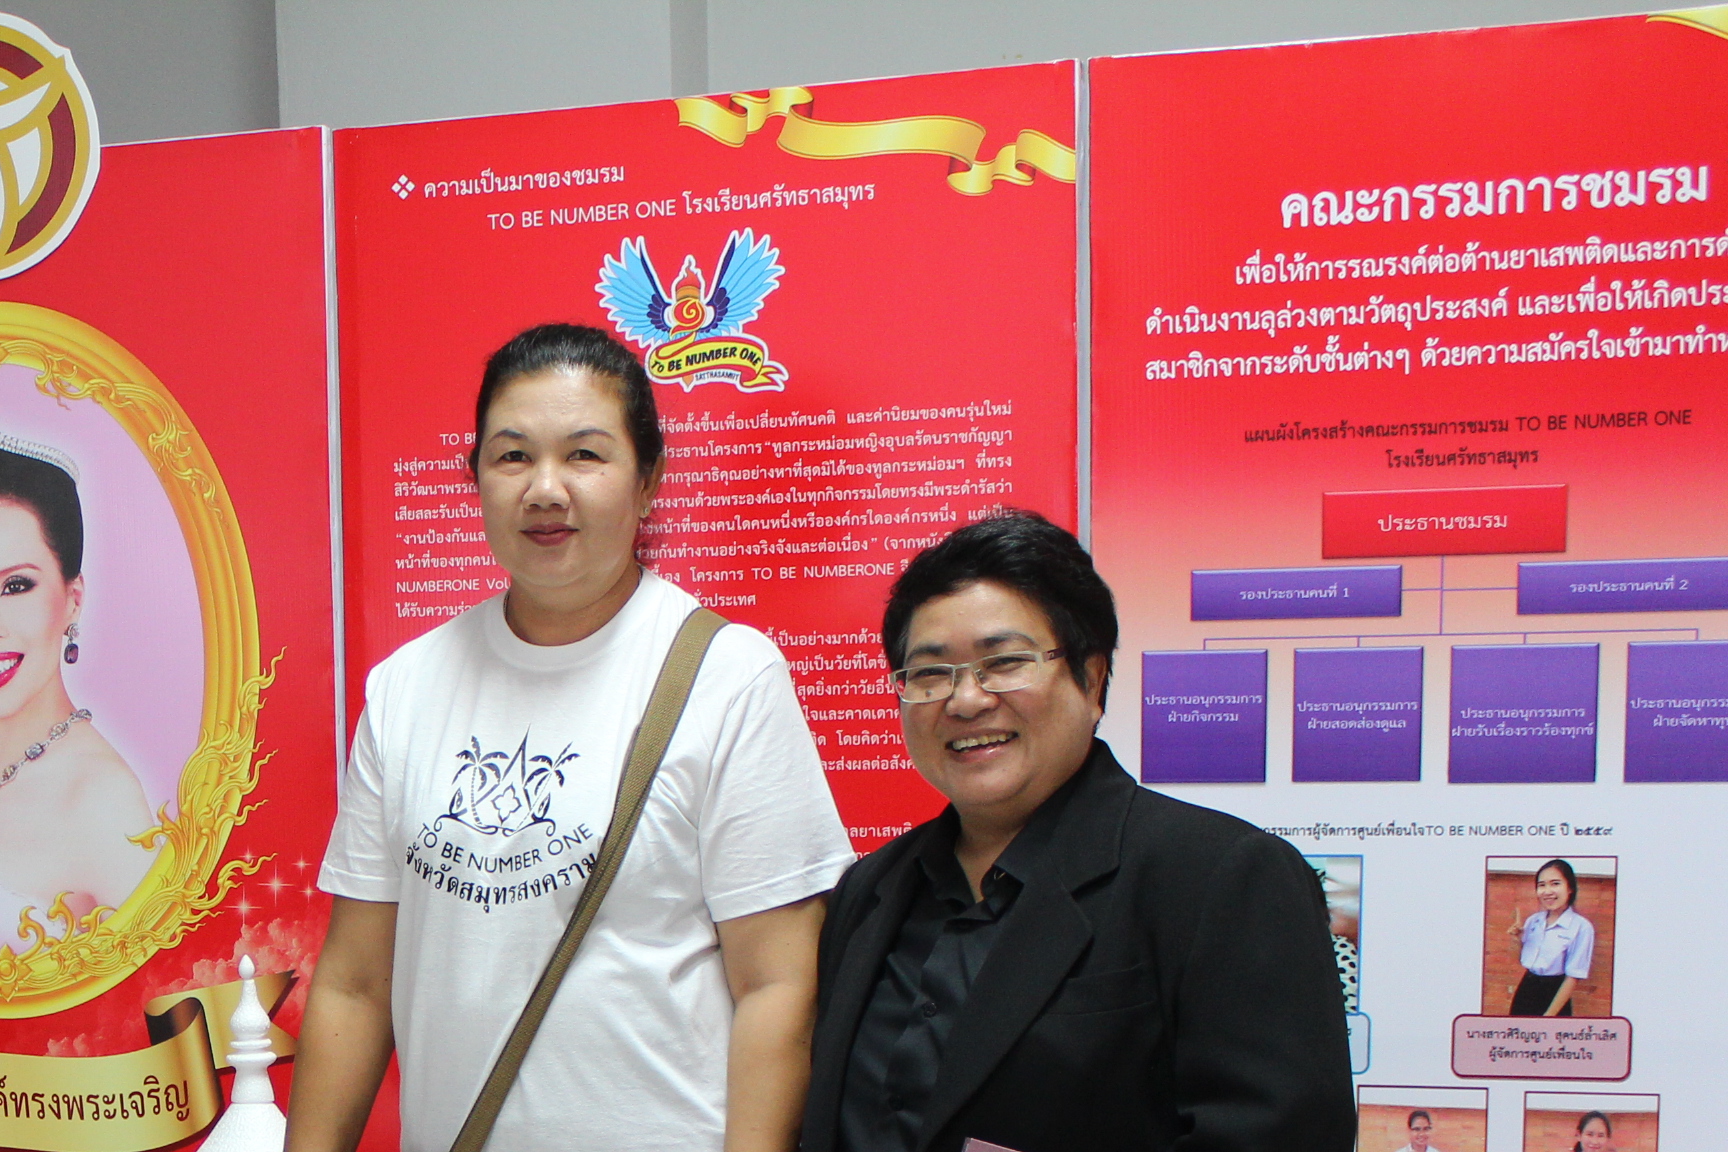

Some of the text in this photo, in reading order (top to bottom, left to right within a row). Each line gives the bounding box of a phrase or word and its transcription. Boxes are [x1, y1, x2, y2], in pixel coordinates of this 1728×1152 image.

[422, 161, 626, 202] ความเป็นมาของชมรม
[486, 181, 876, 231] TO BE NUMBER ONE โรงเรียนศรัทธาสมุทร
[1280, 165, 1709, 229] คณะกรรมการชมรม
[1145, 276, 1728, 339] ดำเนินงานลุล่วงตามวัตถุประสงค์ และเพื่อให้เกิดประ
[650, 346, 762, 373] TO BE NUMBER ONE
[1145, 325, 1728, 382] สมาชิกจากระดับชั้นต่างๆ ด้วยความสมัครใจเข้ามาทำห
[846, 399, 1013, 426] และค่านิยมของคนรุ่นใหม่
[1243, 408, 1693, 446] แผนผังโครงสร้างคณะกรรมการชมรม TO BE NUMBER ONE
[439, 433, 460, 446] TO
[660, 453, 1013, 487] หากรุณาธิคุณอย่างหาที่สุดมิได้ของทูลกระหม่อมฯ ที่ทรง
[1385, 448, 1540, 470] โรงเรียนศรัทธาสมุทร
[1376, 511, 1508, 535] ประธานชมรม
[395, 529, 486, 545] “งานป้องกันแล
[395, 550, 498, 572] หน้าที่ของทุกคนใ
[689, 565, 745, 584] โครงการ
[751, 566, 773, 581] TO
[779, 565, 797, 580] BE
[803, 561, 895, 580] NUMBERONE
[395, 577, 511, 594] NUMBERONE Vol
[1238, 582, 1351, 602] รองประธานคนที่ 1
[1568, 577, 1690, 595] รองประธานคนที่ 2
[395, 602, 478, 618] ได้รับความร่ว
[693, 589, 757, 609] ั่วประเทศ
[1144, 692, 1264, 709] ประธานอนุกรรมการ
[1297, 699, 1419, 716] ประธานอนุกรรมการ
[1167, 709, 1239, 724] ฝ่ายกิจกรรม
[1460, 706, 1586, 722] ประธานอนุกรรมการ
[1449, 825, 1466, 837] BE
[1468, 825, 1525, 837] NUMBER
[1527, 825, 1556, 837] ONE
[1559, 822, 1571, 838] ปี
[416, 822, 594, 874] TO BE NUMBER ONE
[405, 841, 599, 914] จังหวัดสมุทรสงคราม
